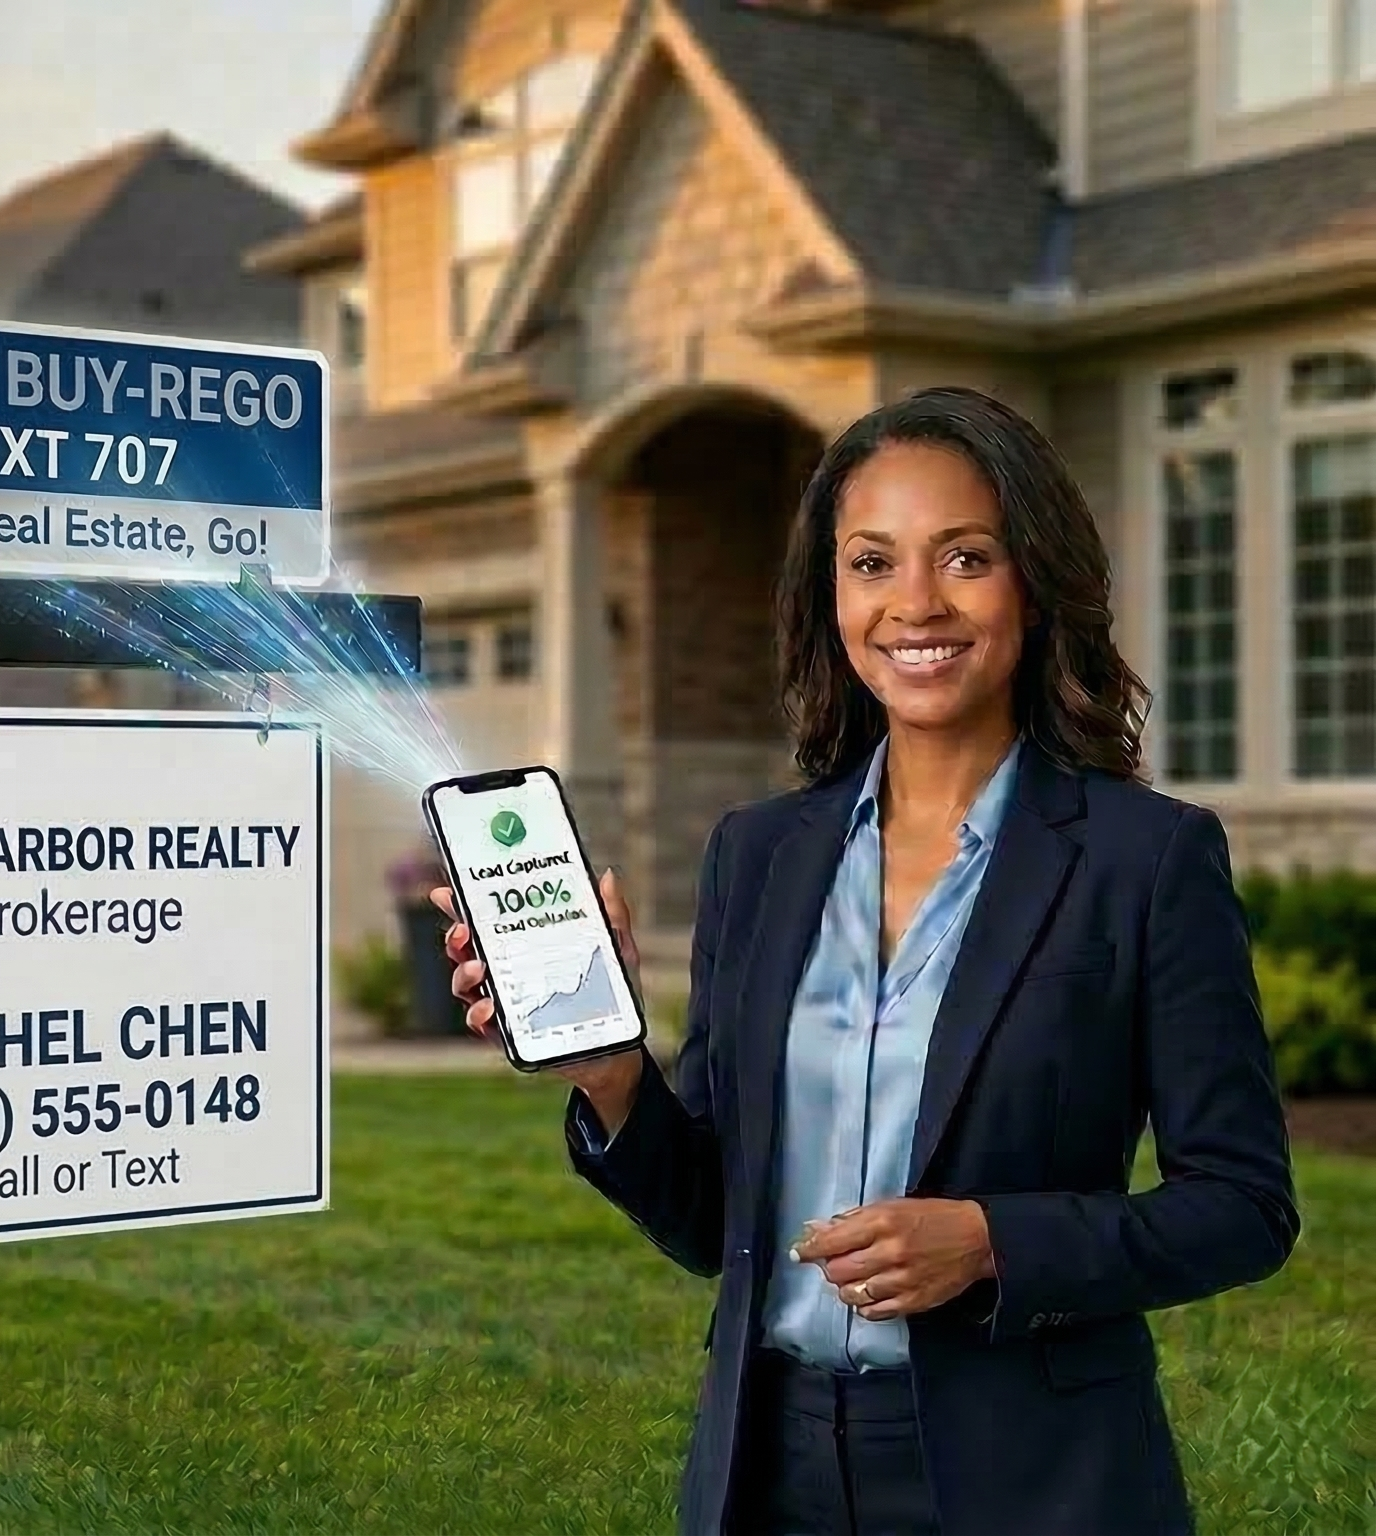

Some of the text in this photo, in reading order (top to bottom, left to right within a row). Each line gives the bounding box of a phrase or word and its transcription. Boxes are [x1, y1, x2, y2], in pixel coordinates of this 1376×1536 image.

[7, 350, 302, 429] BUY-REGO
[84, 432, 178, 486] 707
[65, 507, 195, 559] Estate,
[208, 517, 267, 556] Go!
[148, 825, 301, 870] REALTY
[488, 878, 572, 915] 100%
[120, 999, 267, 1061] CHEN
[31, 1073, 261, 1138] 555-0148
[53, 1161, 92, 1194] or
[101, 1147, 181, 1189] Text
